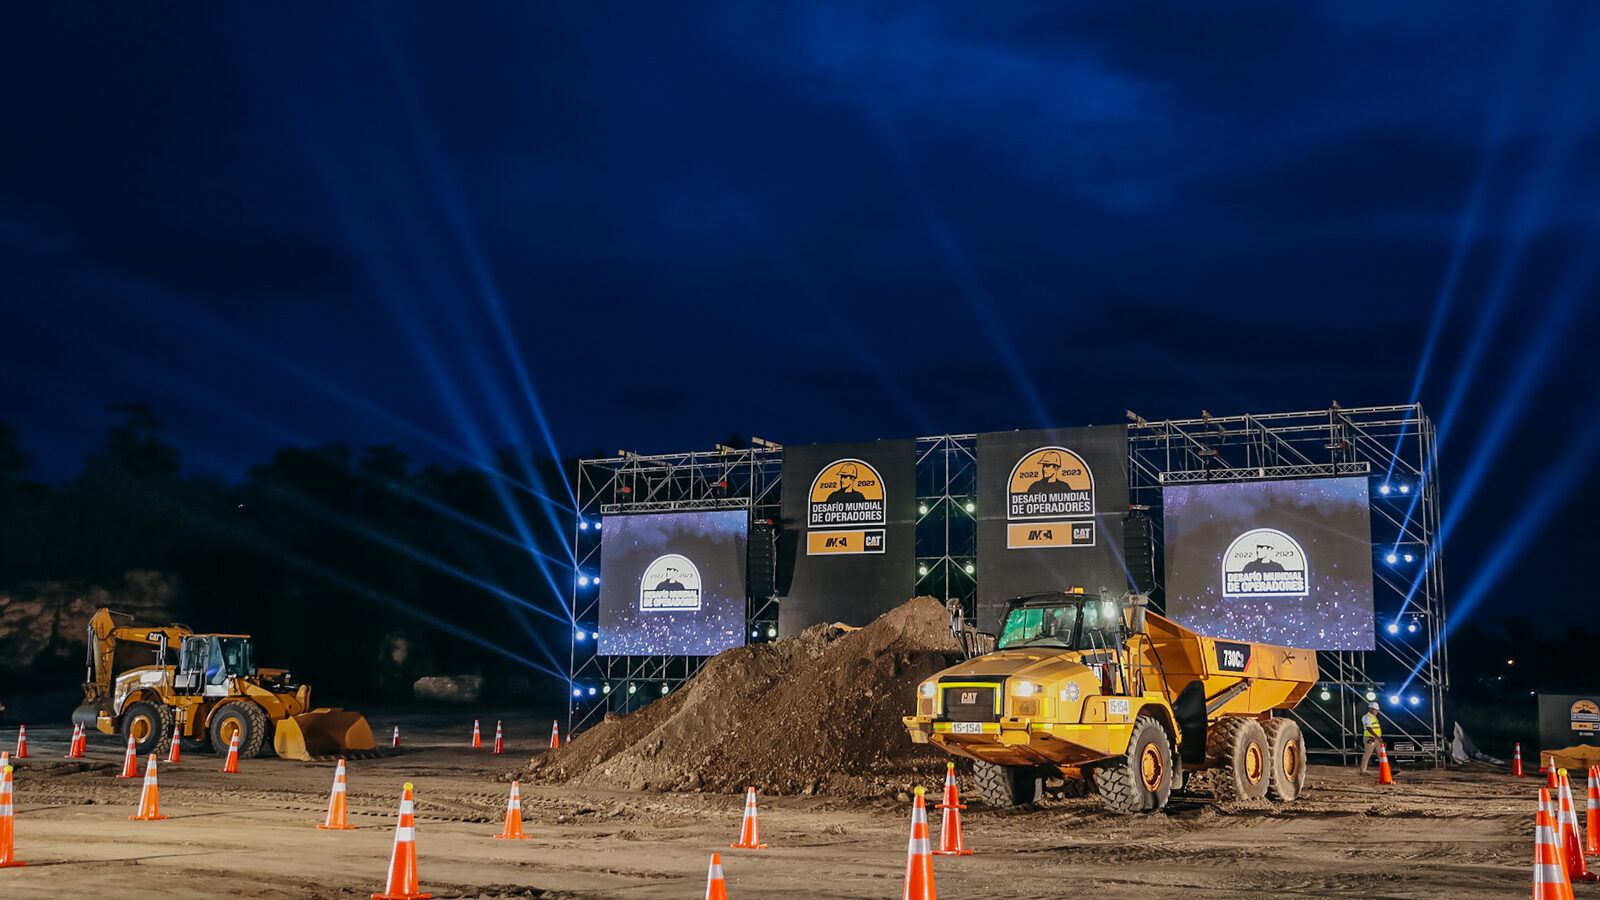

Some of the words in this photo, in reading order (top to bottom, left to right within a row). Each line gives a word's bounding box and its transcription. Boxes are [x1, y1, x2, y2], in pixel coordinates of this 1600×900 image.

[1012, 492, 1047, 504] DESAFÍO
[1049, 492, 1090, 502] MUNDIAL
[812, 502, 844, 512] DESAFÍO
[845, 502, 882, 511] MUNDIAL
[1012, 504, 1024, 514] DE
[1026, 502, 1090, 514] OPERADORES
[812, 513, 824, 523] DE
[825, 511, 882, 522] OPERADORES
[1073, 528, 1091, 540] CAT
[866, 536, 881, 546] CAT
[1226, 582, 1240, 592] DE
[1240, 580, 1304, 592] OPERADORES
[961, 692, 977, 704] CAT
[1110, 700, 1128, 713] 15-154
[953, 723, 981, 733] 15-154
